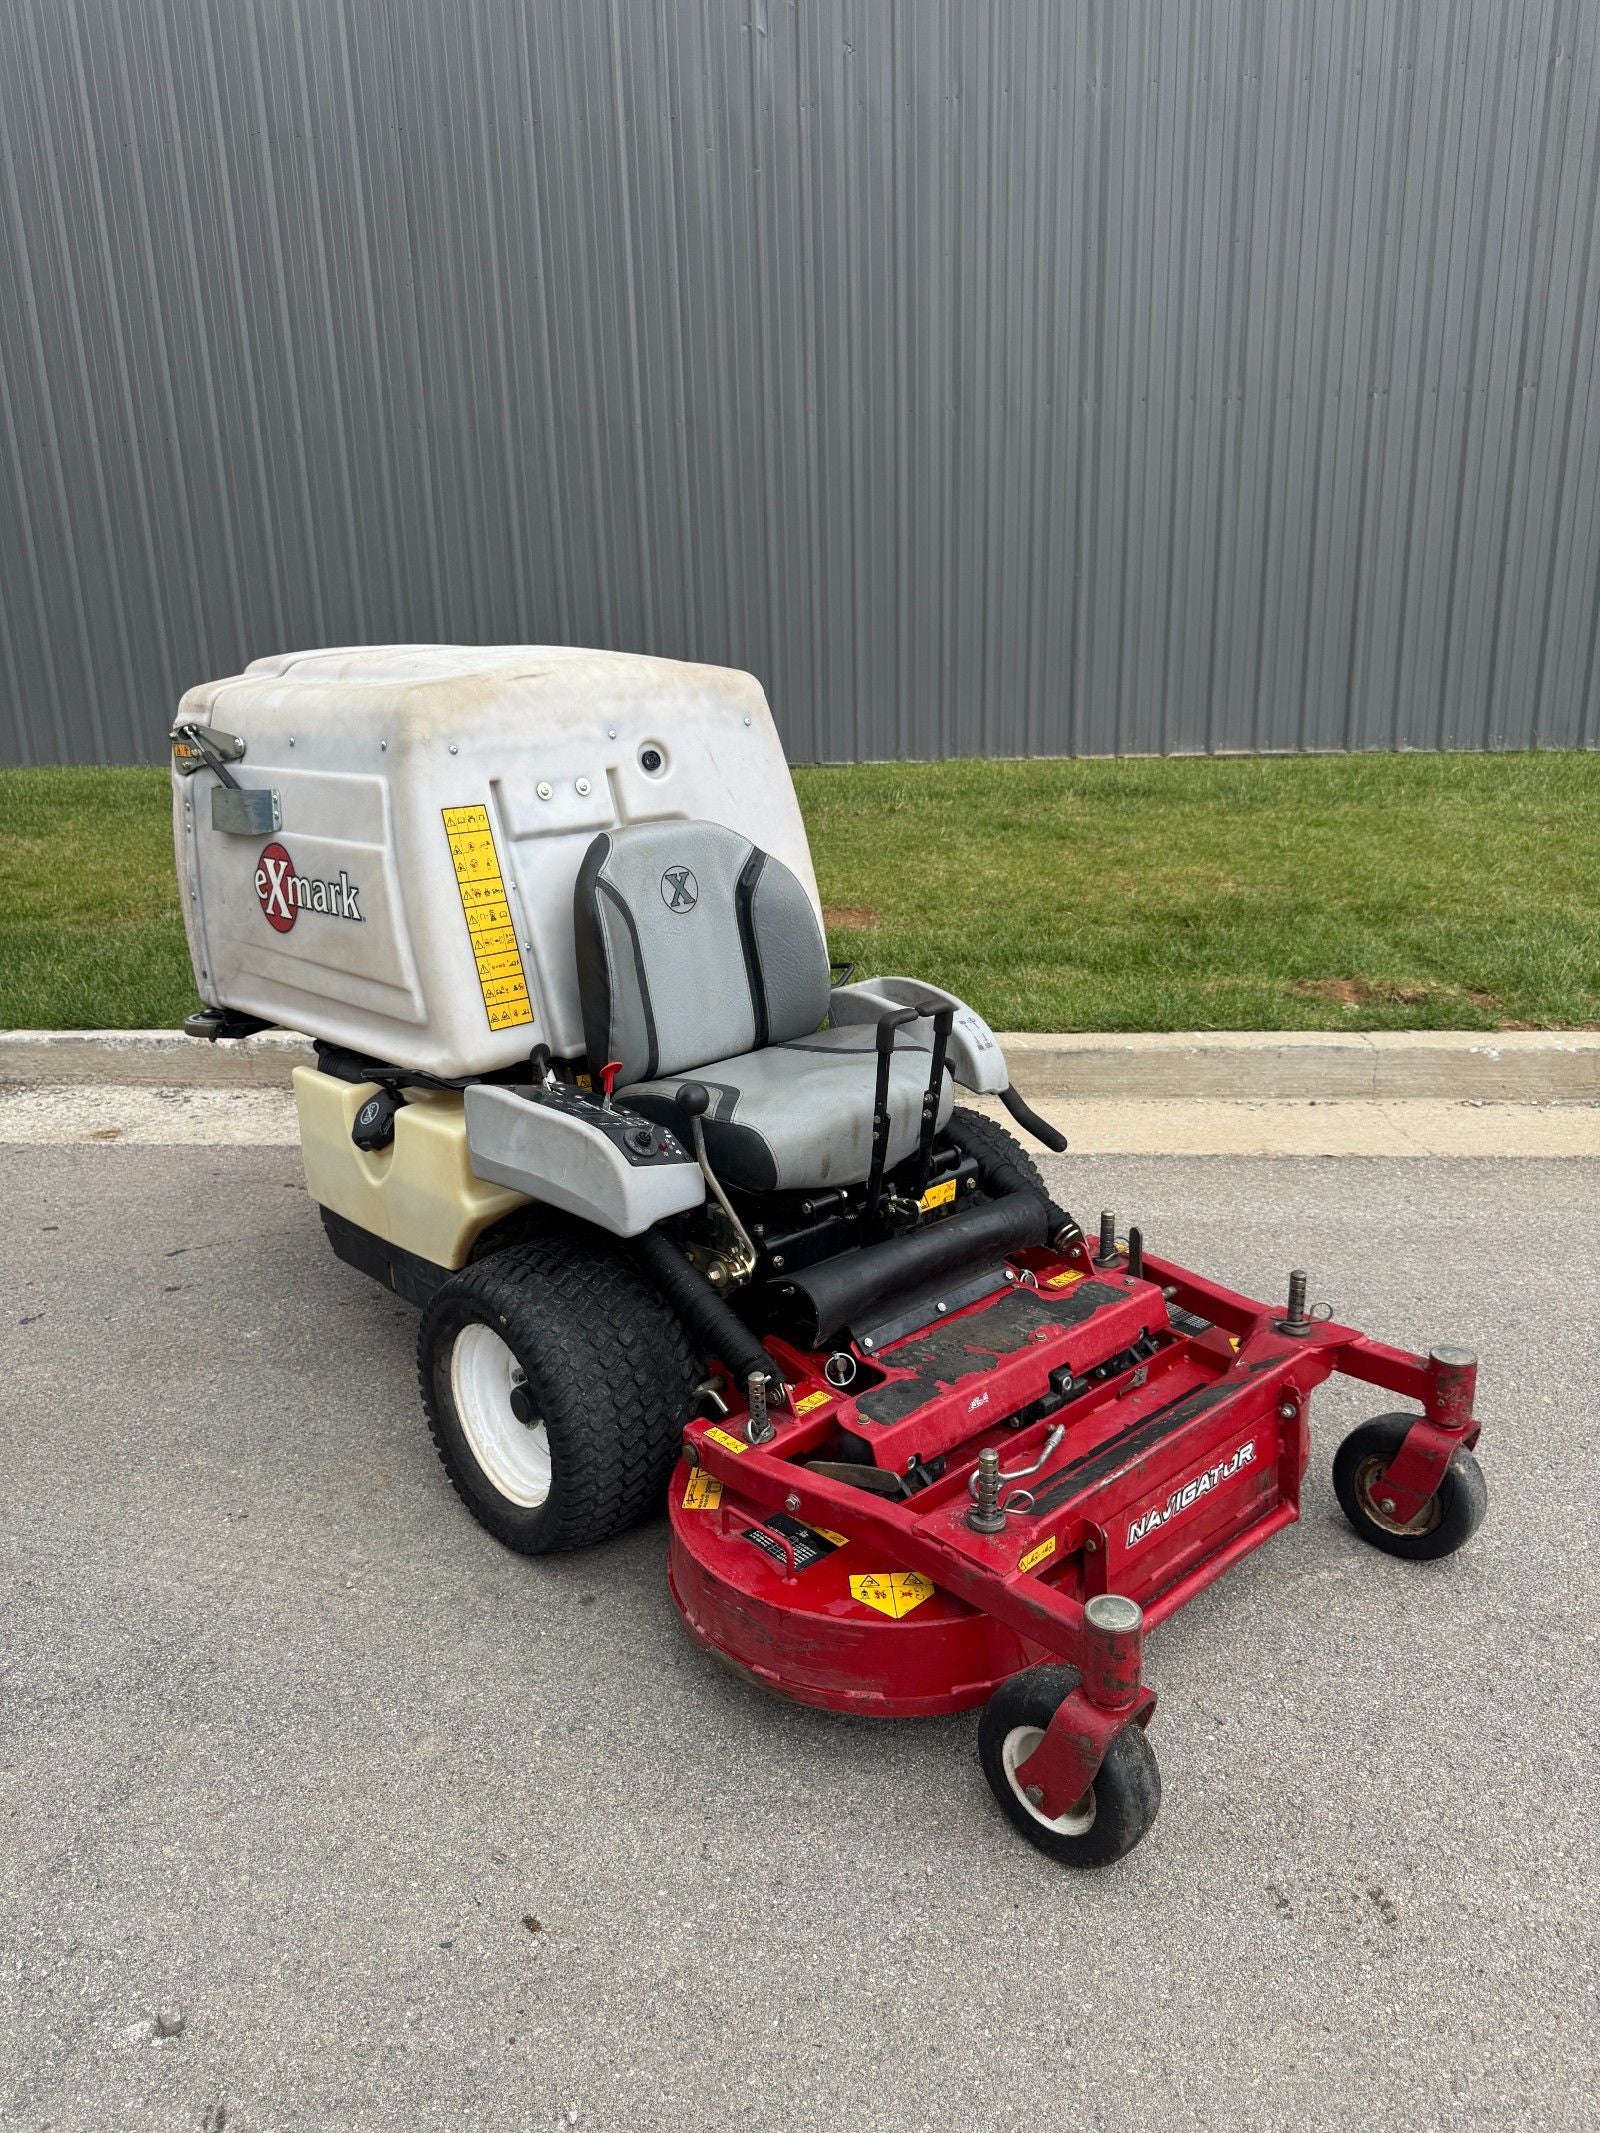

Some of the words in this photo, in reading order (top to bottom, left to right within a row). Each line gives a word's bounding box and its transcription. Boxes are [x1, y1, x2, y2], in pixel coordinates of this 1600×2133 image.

[254, 856, 363, 921] eXmark
[664, 871, 696, 907] X
[1125, 1439, 1257, 1549] NAVIGATOR
